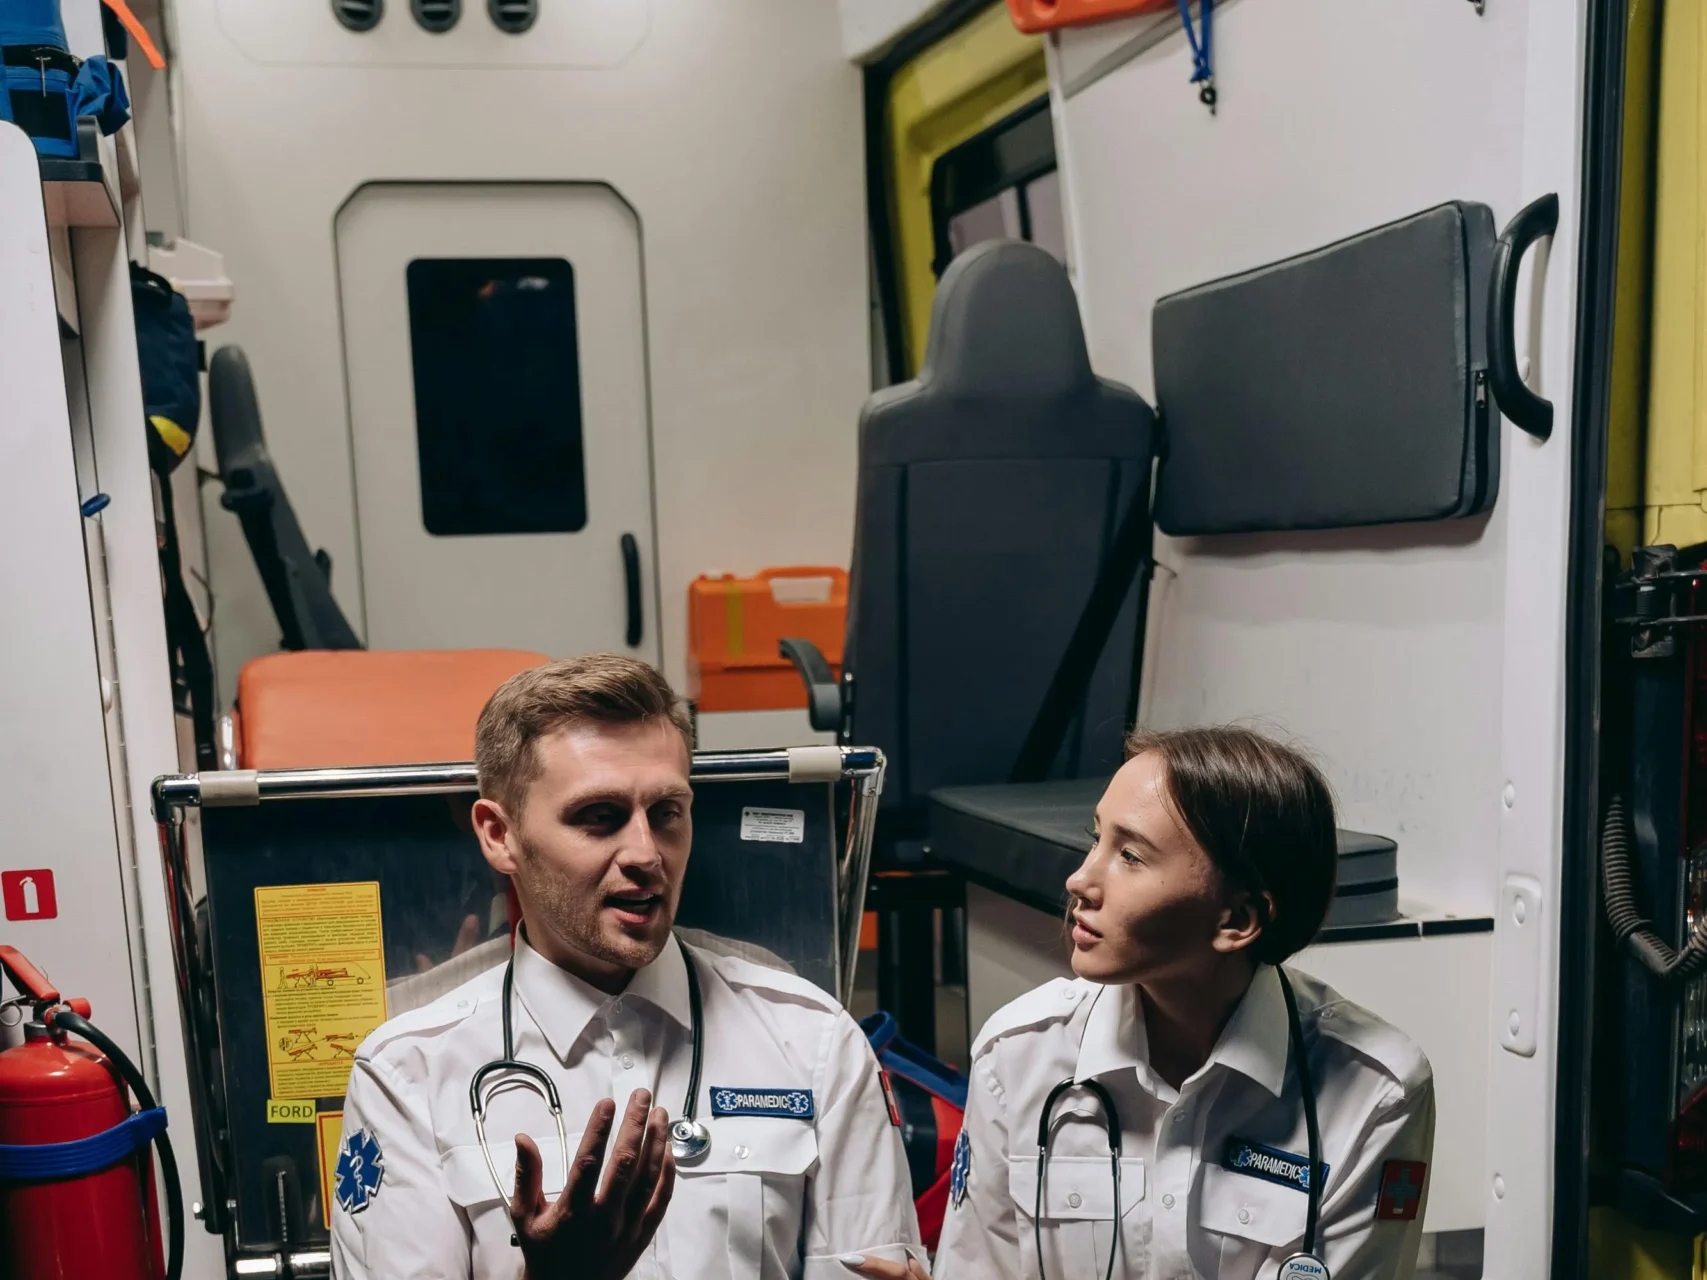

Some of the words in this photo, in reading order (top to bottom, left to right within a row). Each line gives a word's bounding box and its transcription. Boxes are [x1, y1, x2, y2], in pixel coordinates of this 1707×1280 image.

[736, 1093, 788, 1109] PARAMEDIC
[271, 1105, 313, 1118] FORD
[1249, 1152, 1301, 1180] PARAMEDIC
[1289, 1262, 1322, 1274] MEDICA
